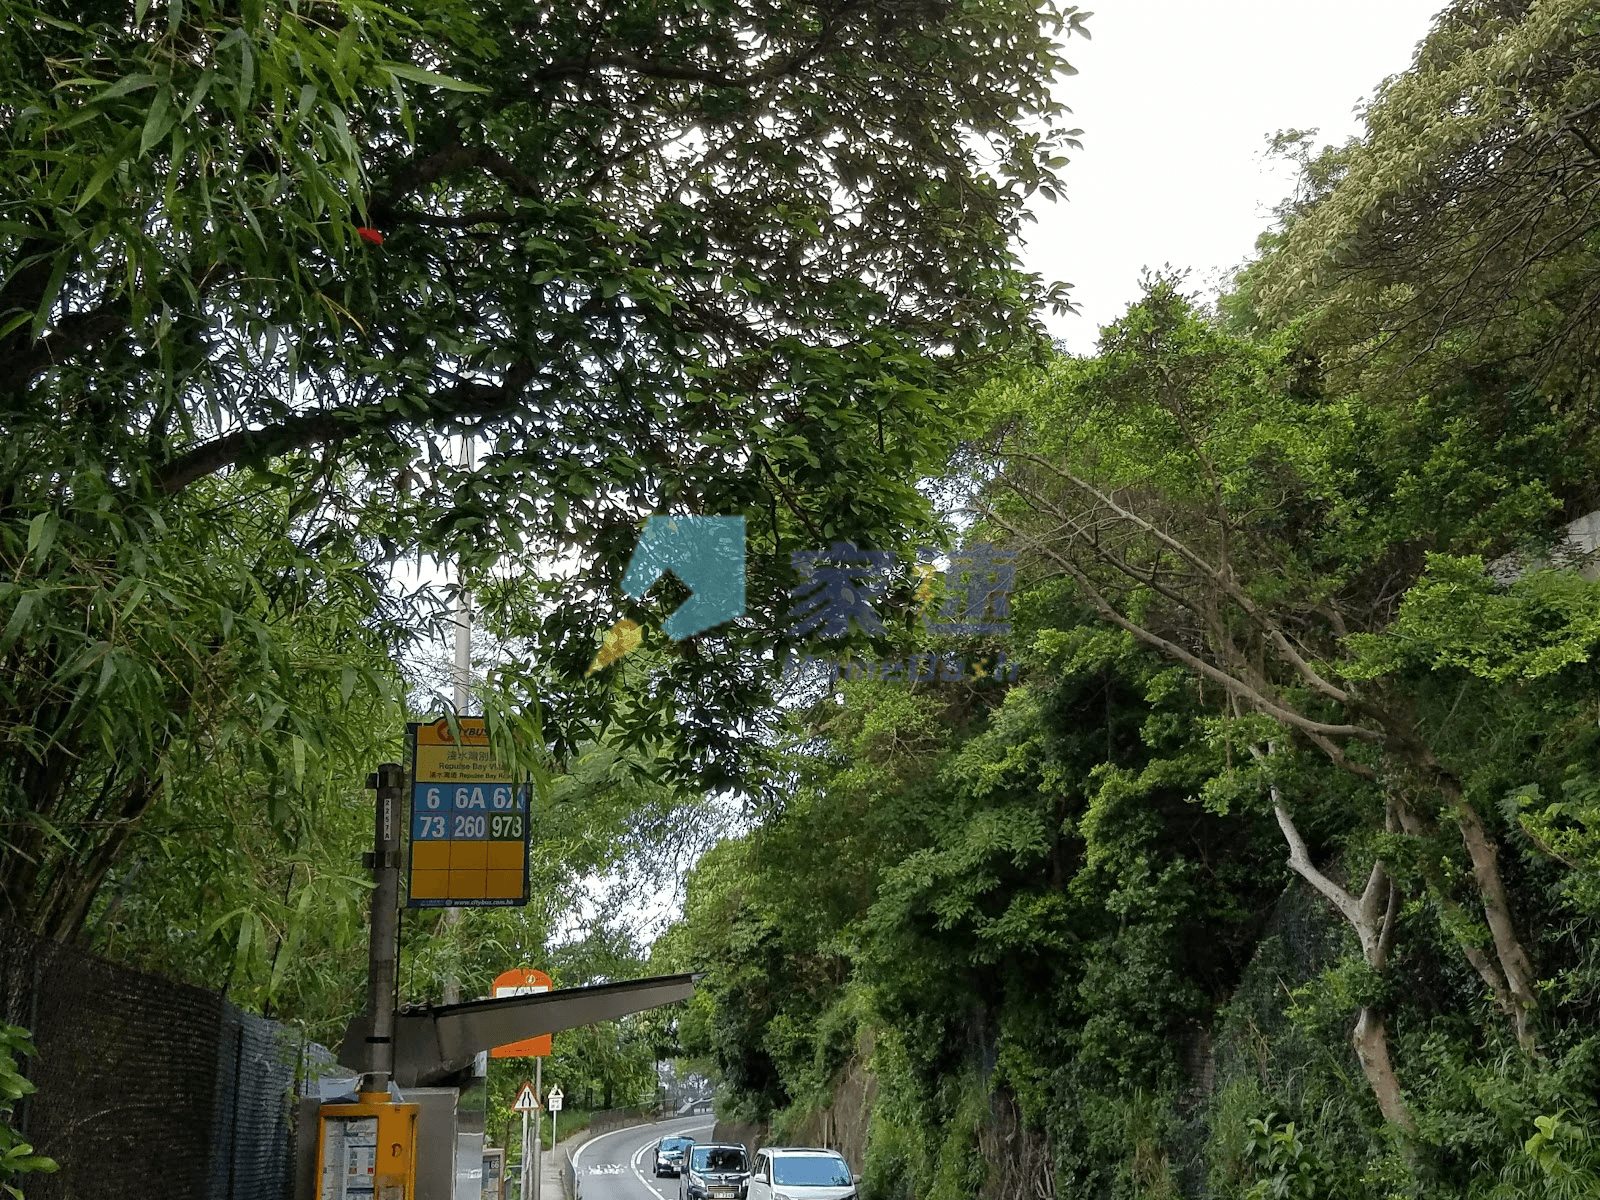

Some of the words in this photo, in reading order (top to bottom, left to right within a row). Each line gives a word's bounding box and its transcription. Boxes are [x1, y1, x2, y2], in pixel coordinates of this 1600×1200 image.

[447, 728, 488, 736] CTYBUS
[439, 762, 471, 771] Repulse
[472, 763, 487, 771] Bay
[426, 787, 440, 809] 6
[455, 787, 486, 809] 6A
[493, 787, 522, 809] 6X
[420, 816, 445, 838] 73
[454, 815, 485, 837] 260
[492, 816, 522, 838] 973
